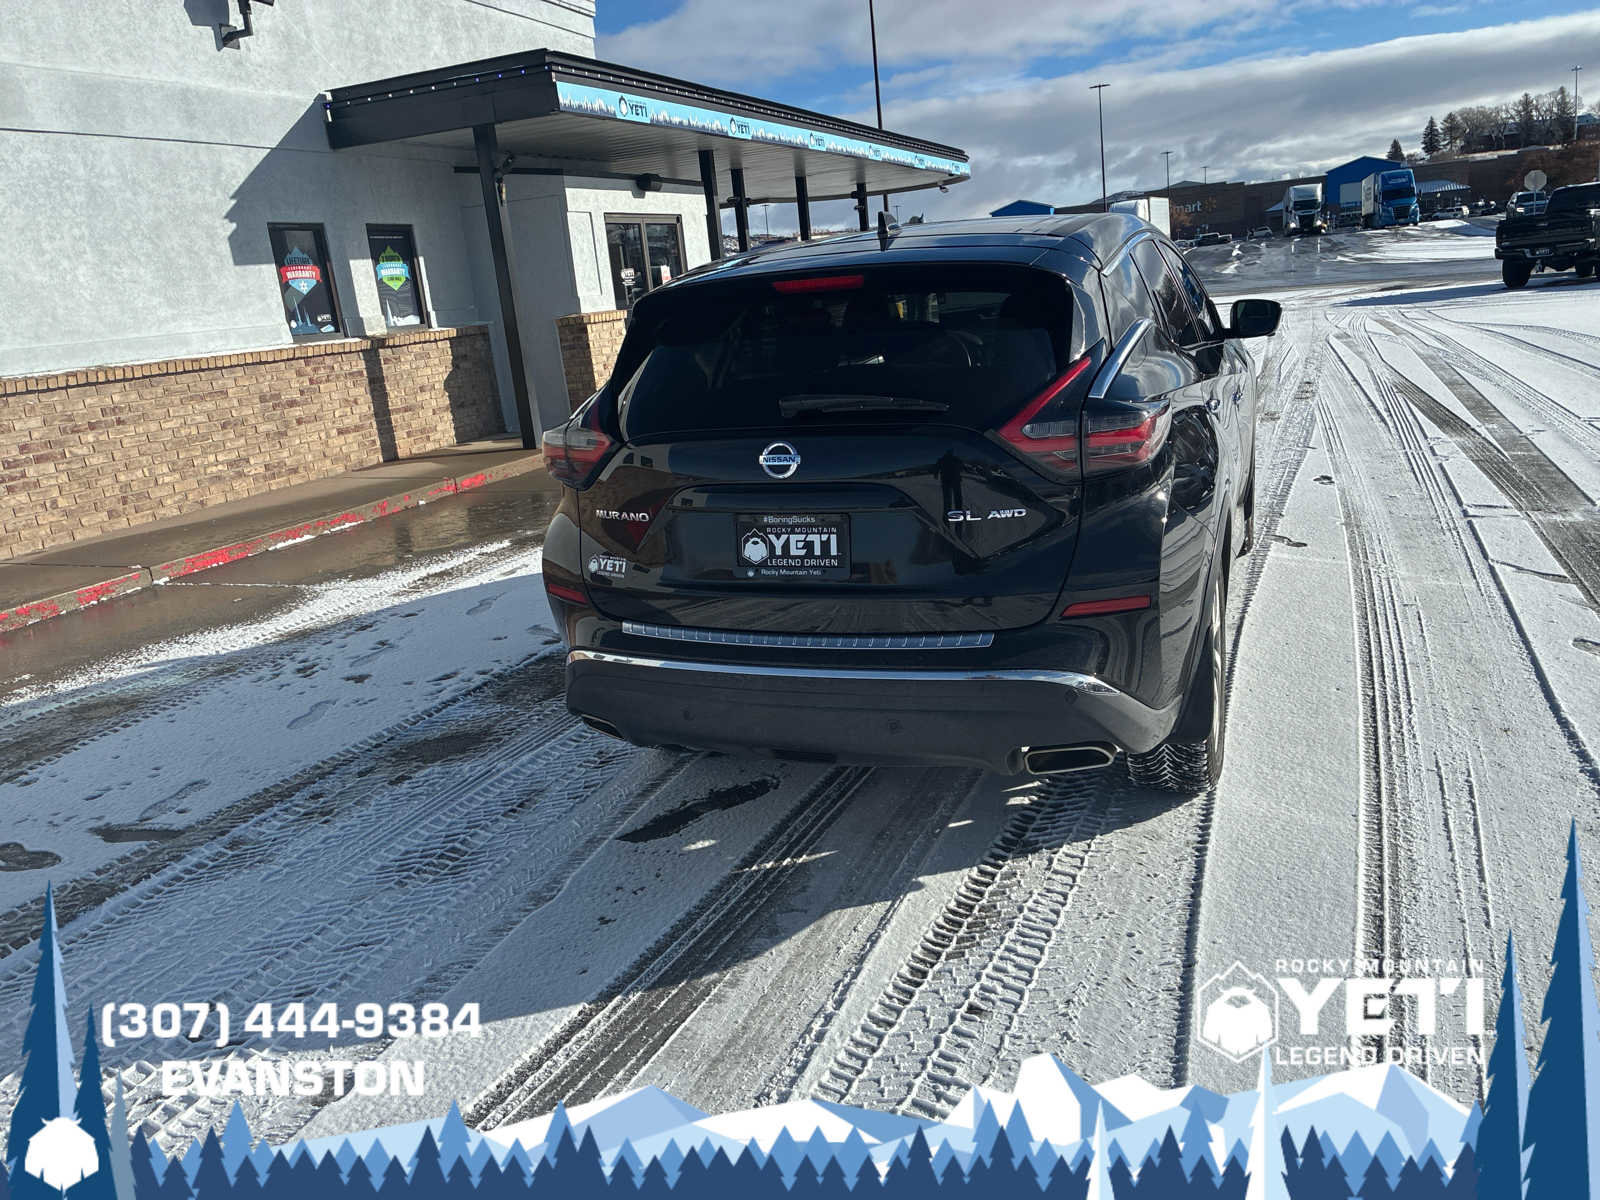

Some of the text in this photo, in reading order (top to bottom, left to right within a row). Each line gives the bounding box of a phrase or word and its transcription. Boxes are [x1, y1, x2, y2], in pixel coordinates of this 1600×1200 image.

[628, 103, 648, 118] YETI
[737, 124, 750, 135] YETI
[286, 270, 316, 279] WARRANTY
[595, 509, 649, 522] MURANO
[764, 516, 816, 525] #BoringSucks
[947, 508, 1026, 522] SL AWD
[767, 534, 838, 556] YETI
[600, 558, 626, 573] YETI
[761, 569, 779, 577] Rocky
